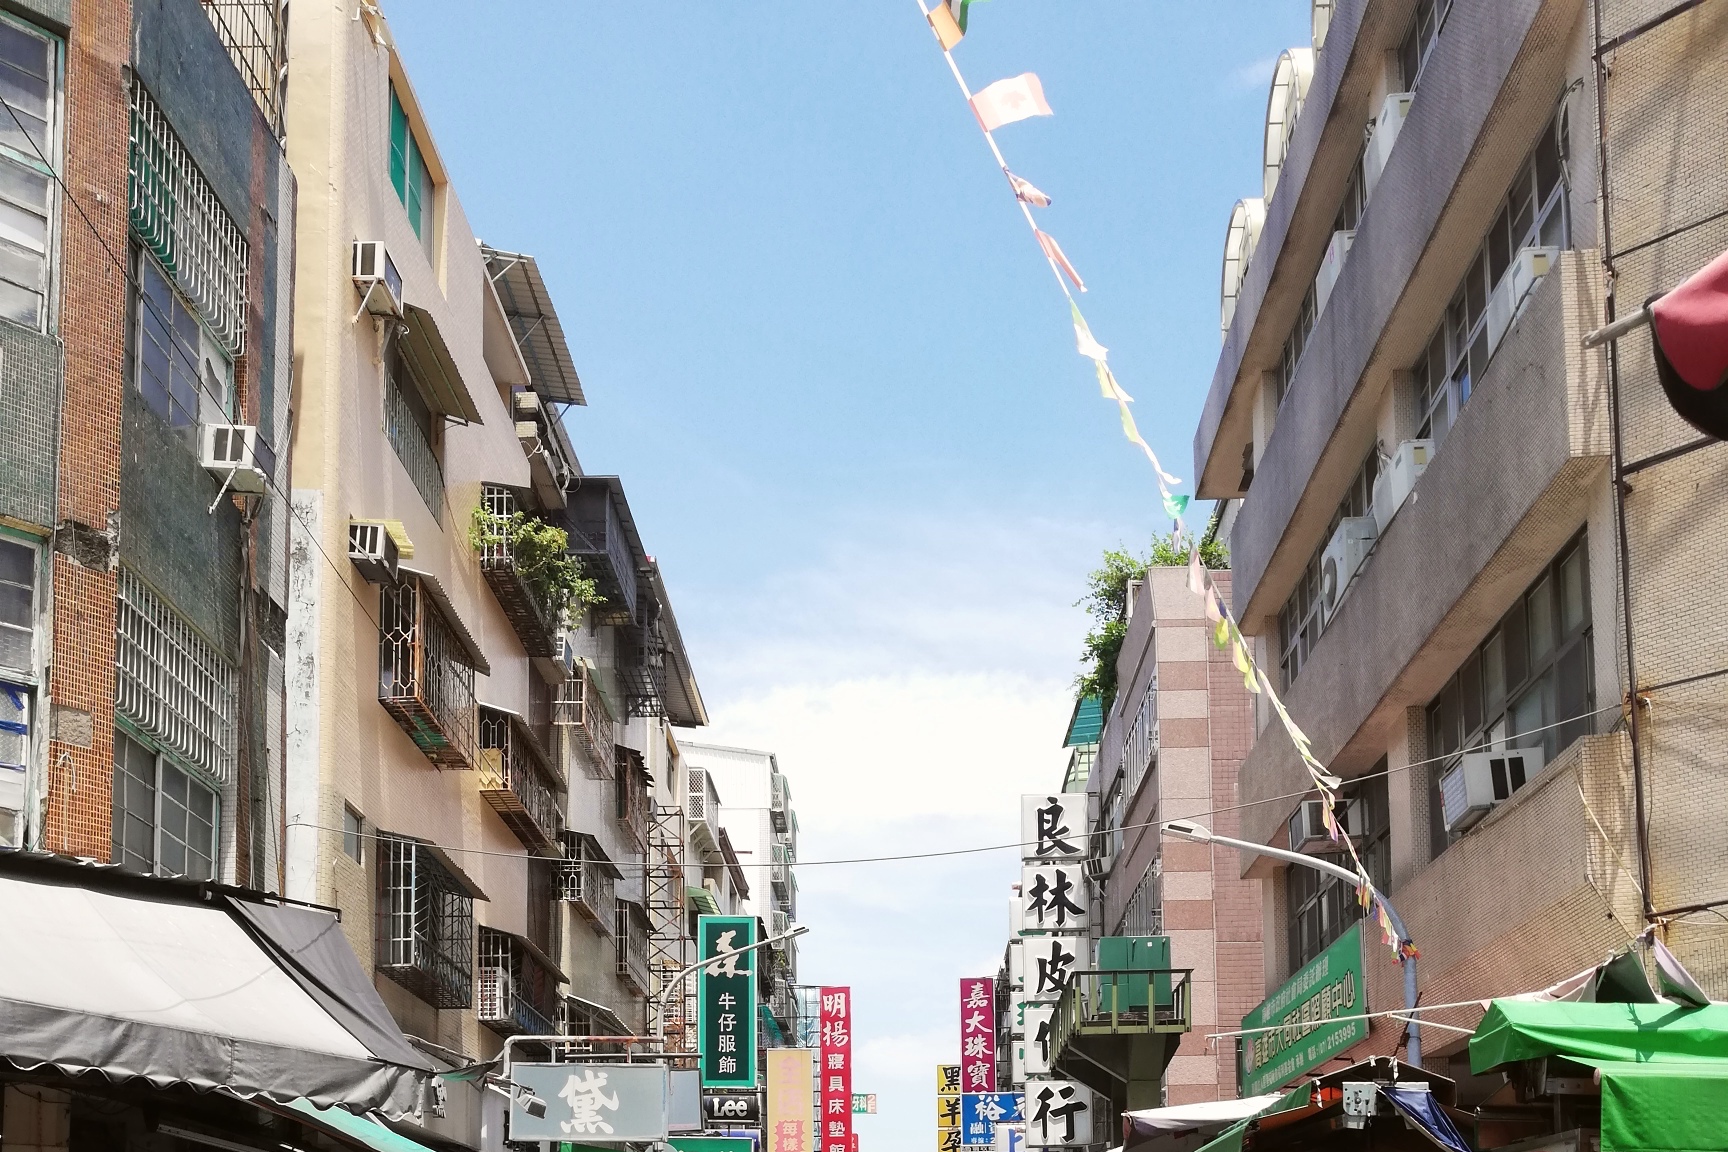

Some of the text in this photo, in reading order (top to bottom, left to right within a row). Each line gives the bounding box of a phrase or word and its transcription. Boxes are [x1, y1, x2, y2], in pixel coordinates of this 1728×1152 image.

[718, 993, 737, 1074] 牛仔服飾
[963, 982, 993, 1093] 嘉大珠寶
[558, 1069, 619, 1134] 黛
[713, 1097, 748, 1117] Lee
[852, 1095, 866, 1111] 牙科
[782, 1123, 798, 1151] 每樣
